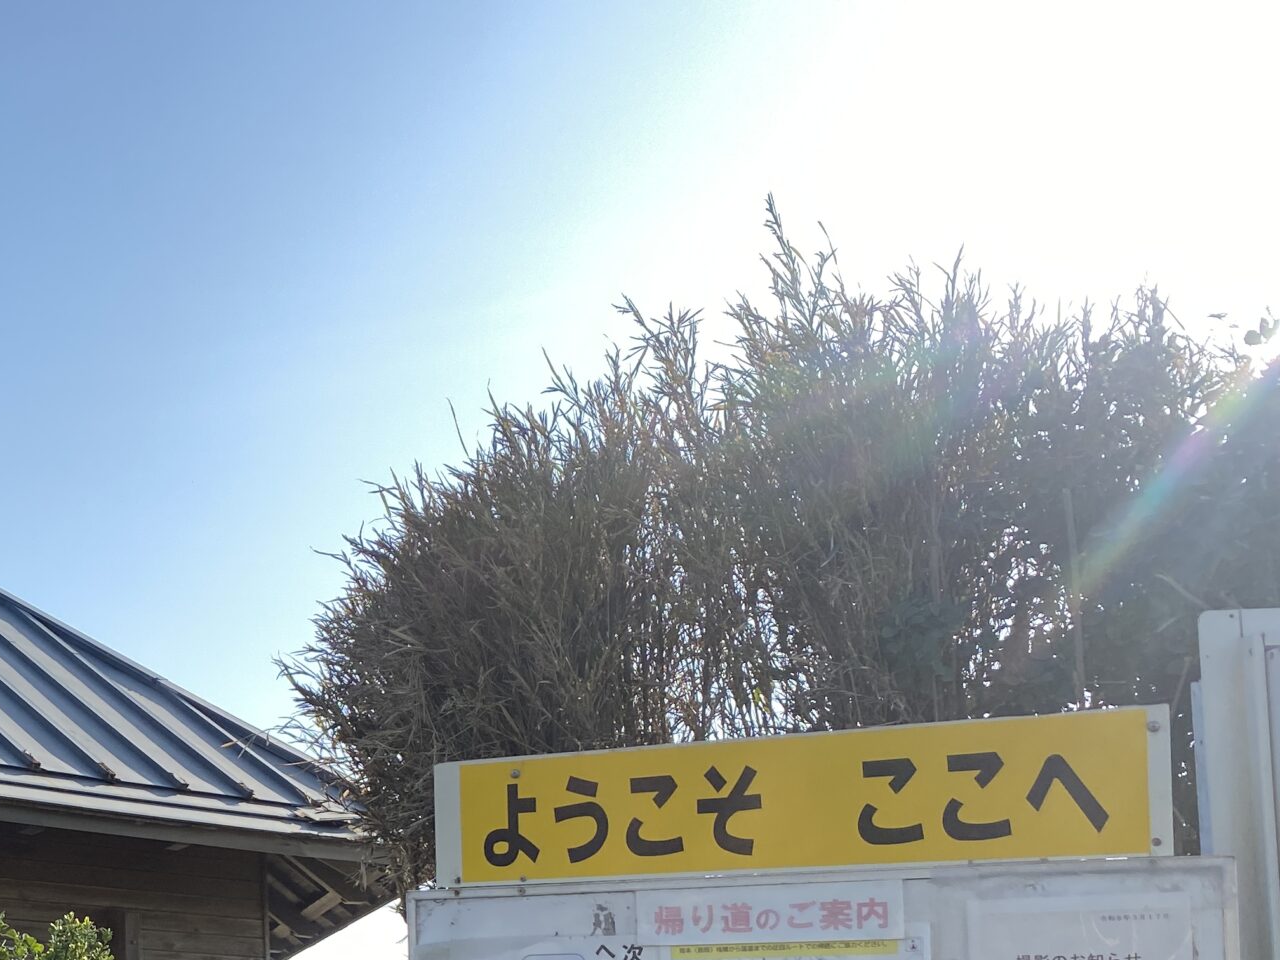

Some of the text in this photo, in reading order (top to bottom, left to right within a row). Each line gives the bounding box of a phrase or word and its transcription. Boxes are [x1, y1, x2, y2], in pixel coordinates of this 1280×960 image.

[484, 751, 1110, 867] ようこそ ここへ
[654, 897, 889, 936] 帰り道のご案内
